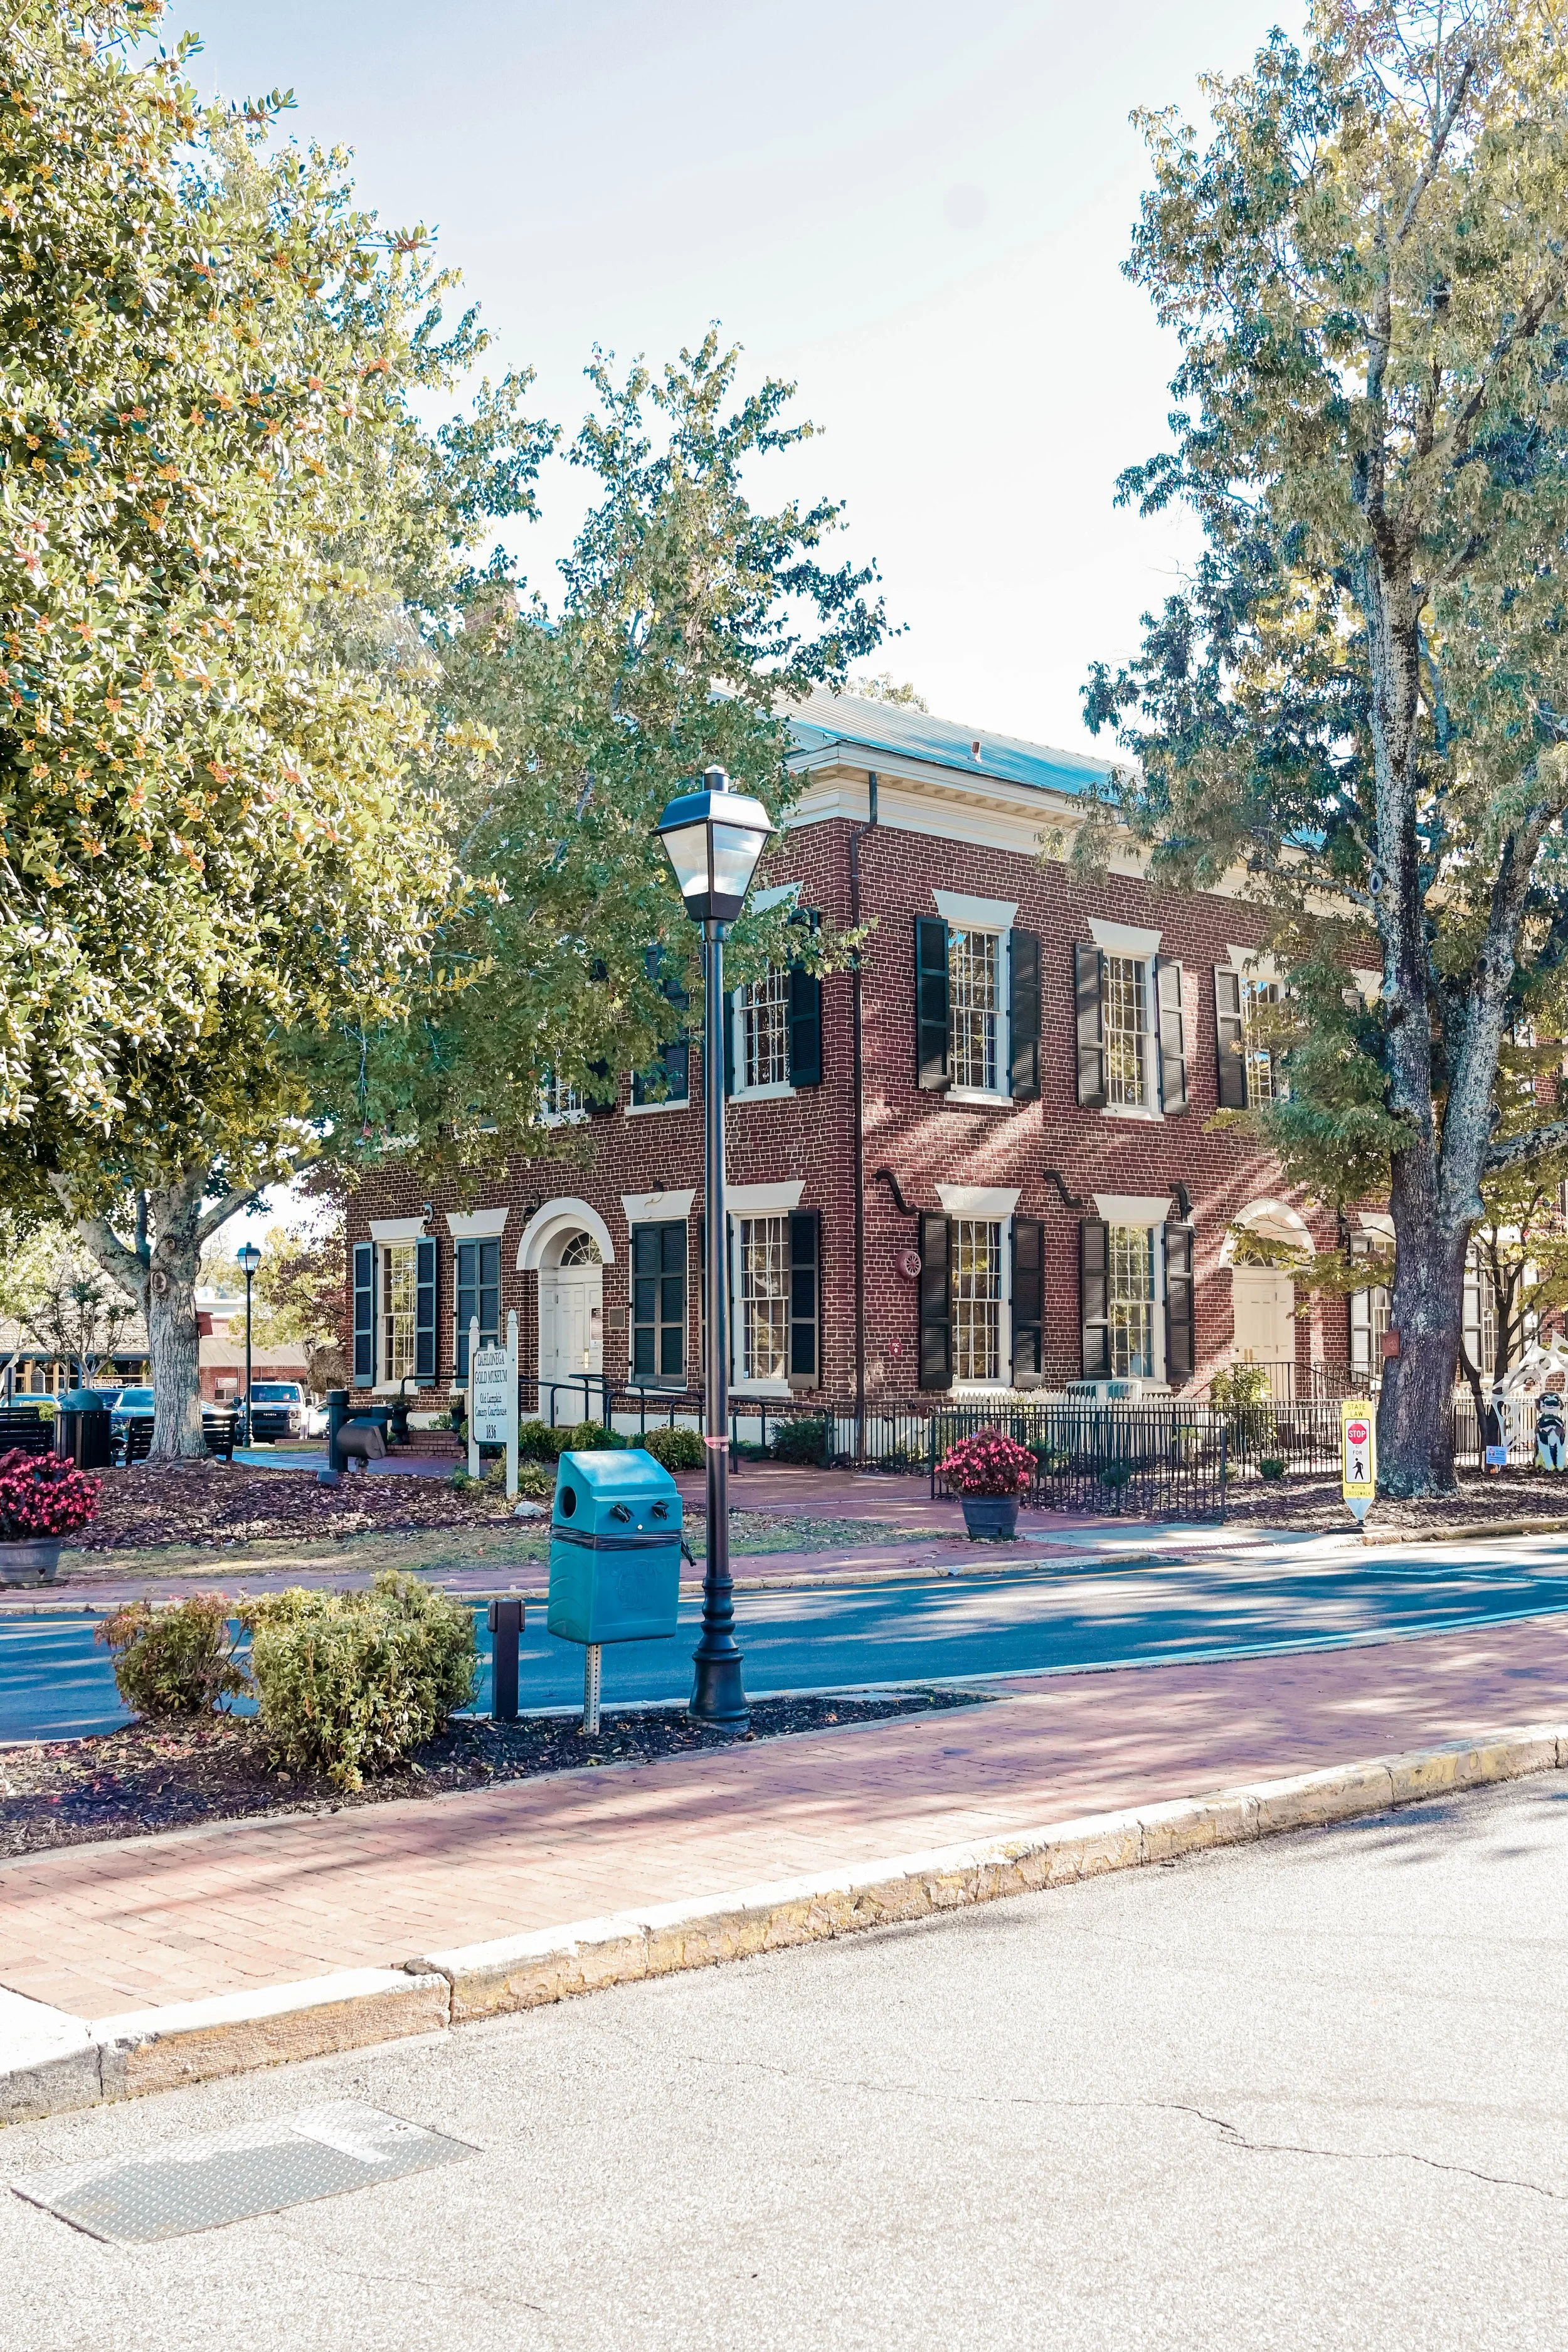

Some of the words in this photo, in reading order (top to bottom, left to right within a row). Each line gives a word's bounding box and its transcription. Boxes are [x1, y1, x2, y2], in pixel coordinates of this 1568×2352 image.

[477, 1352, 505, 1366] DAHLONEGA
[475, 1371, 487, 1384] GOLD
[488, 1369, 507, 1384] MUSEUM
[487, 1392, 502, 1406] Lumpkin
[475, 1406, 487, 1420] County
[488, 1405, 507, 1416] Courthouse
[486, 1424, 497, 1439] 1836
[1348, 1430, 1366, 1438] STOP
